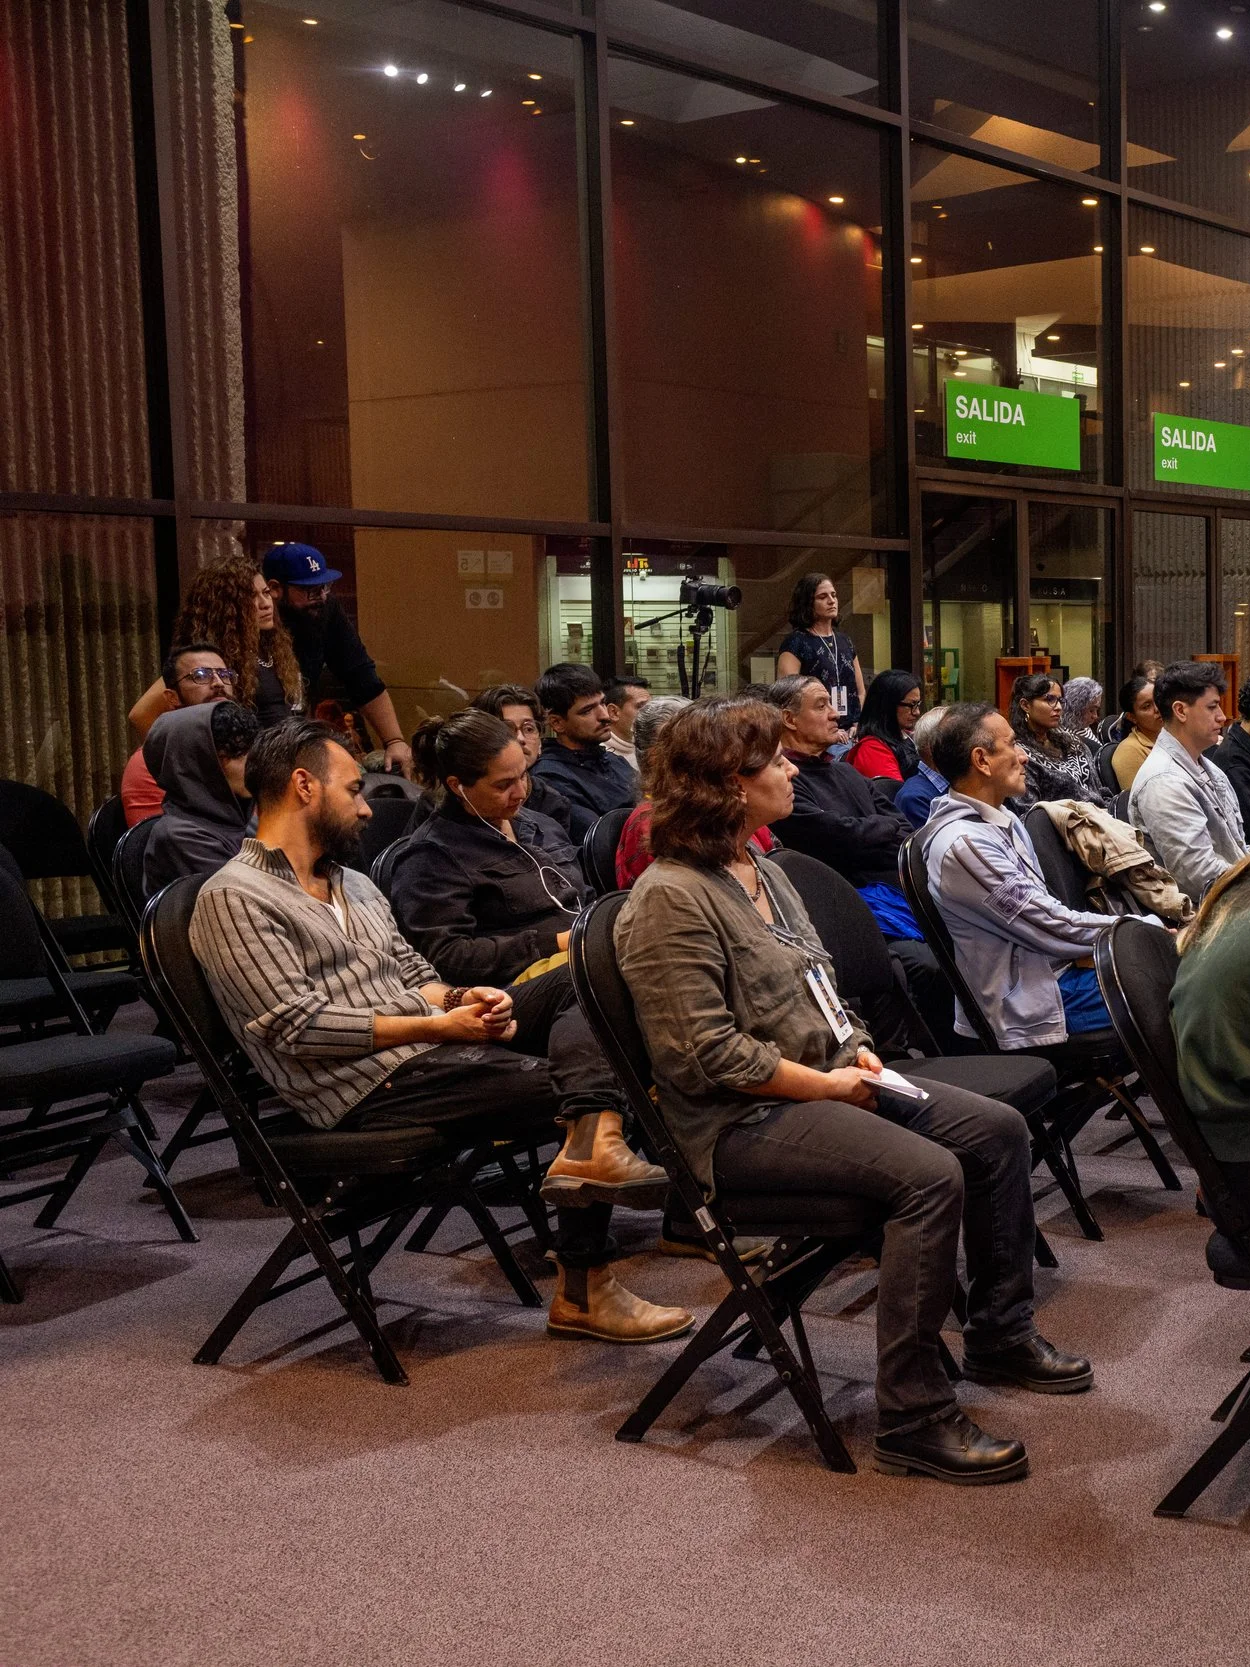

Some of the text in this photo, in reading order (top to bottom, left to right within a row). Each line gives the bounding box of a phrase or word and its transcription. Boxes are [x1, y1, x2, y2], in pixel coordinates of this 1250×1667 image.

[955, 395, 1026, 427] SALIDA
[955, 430, 977, 445] exit
[1161, 426, 1217, 453] SALIDA
[1161, 457, 1178, 470] exit
[306, 556, 321, 572] LA
